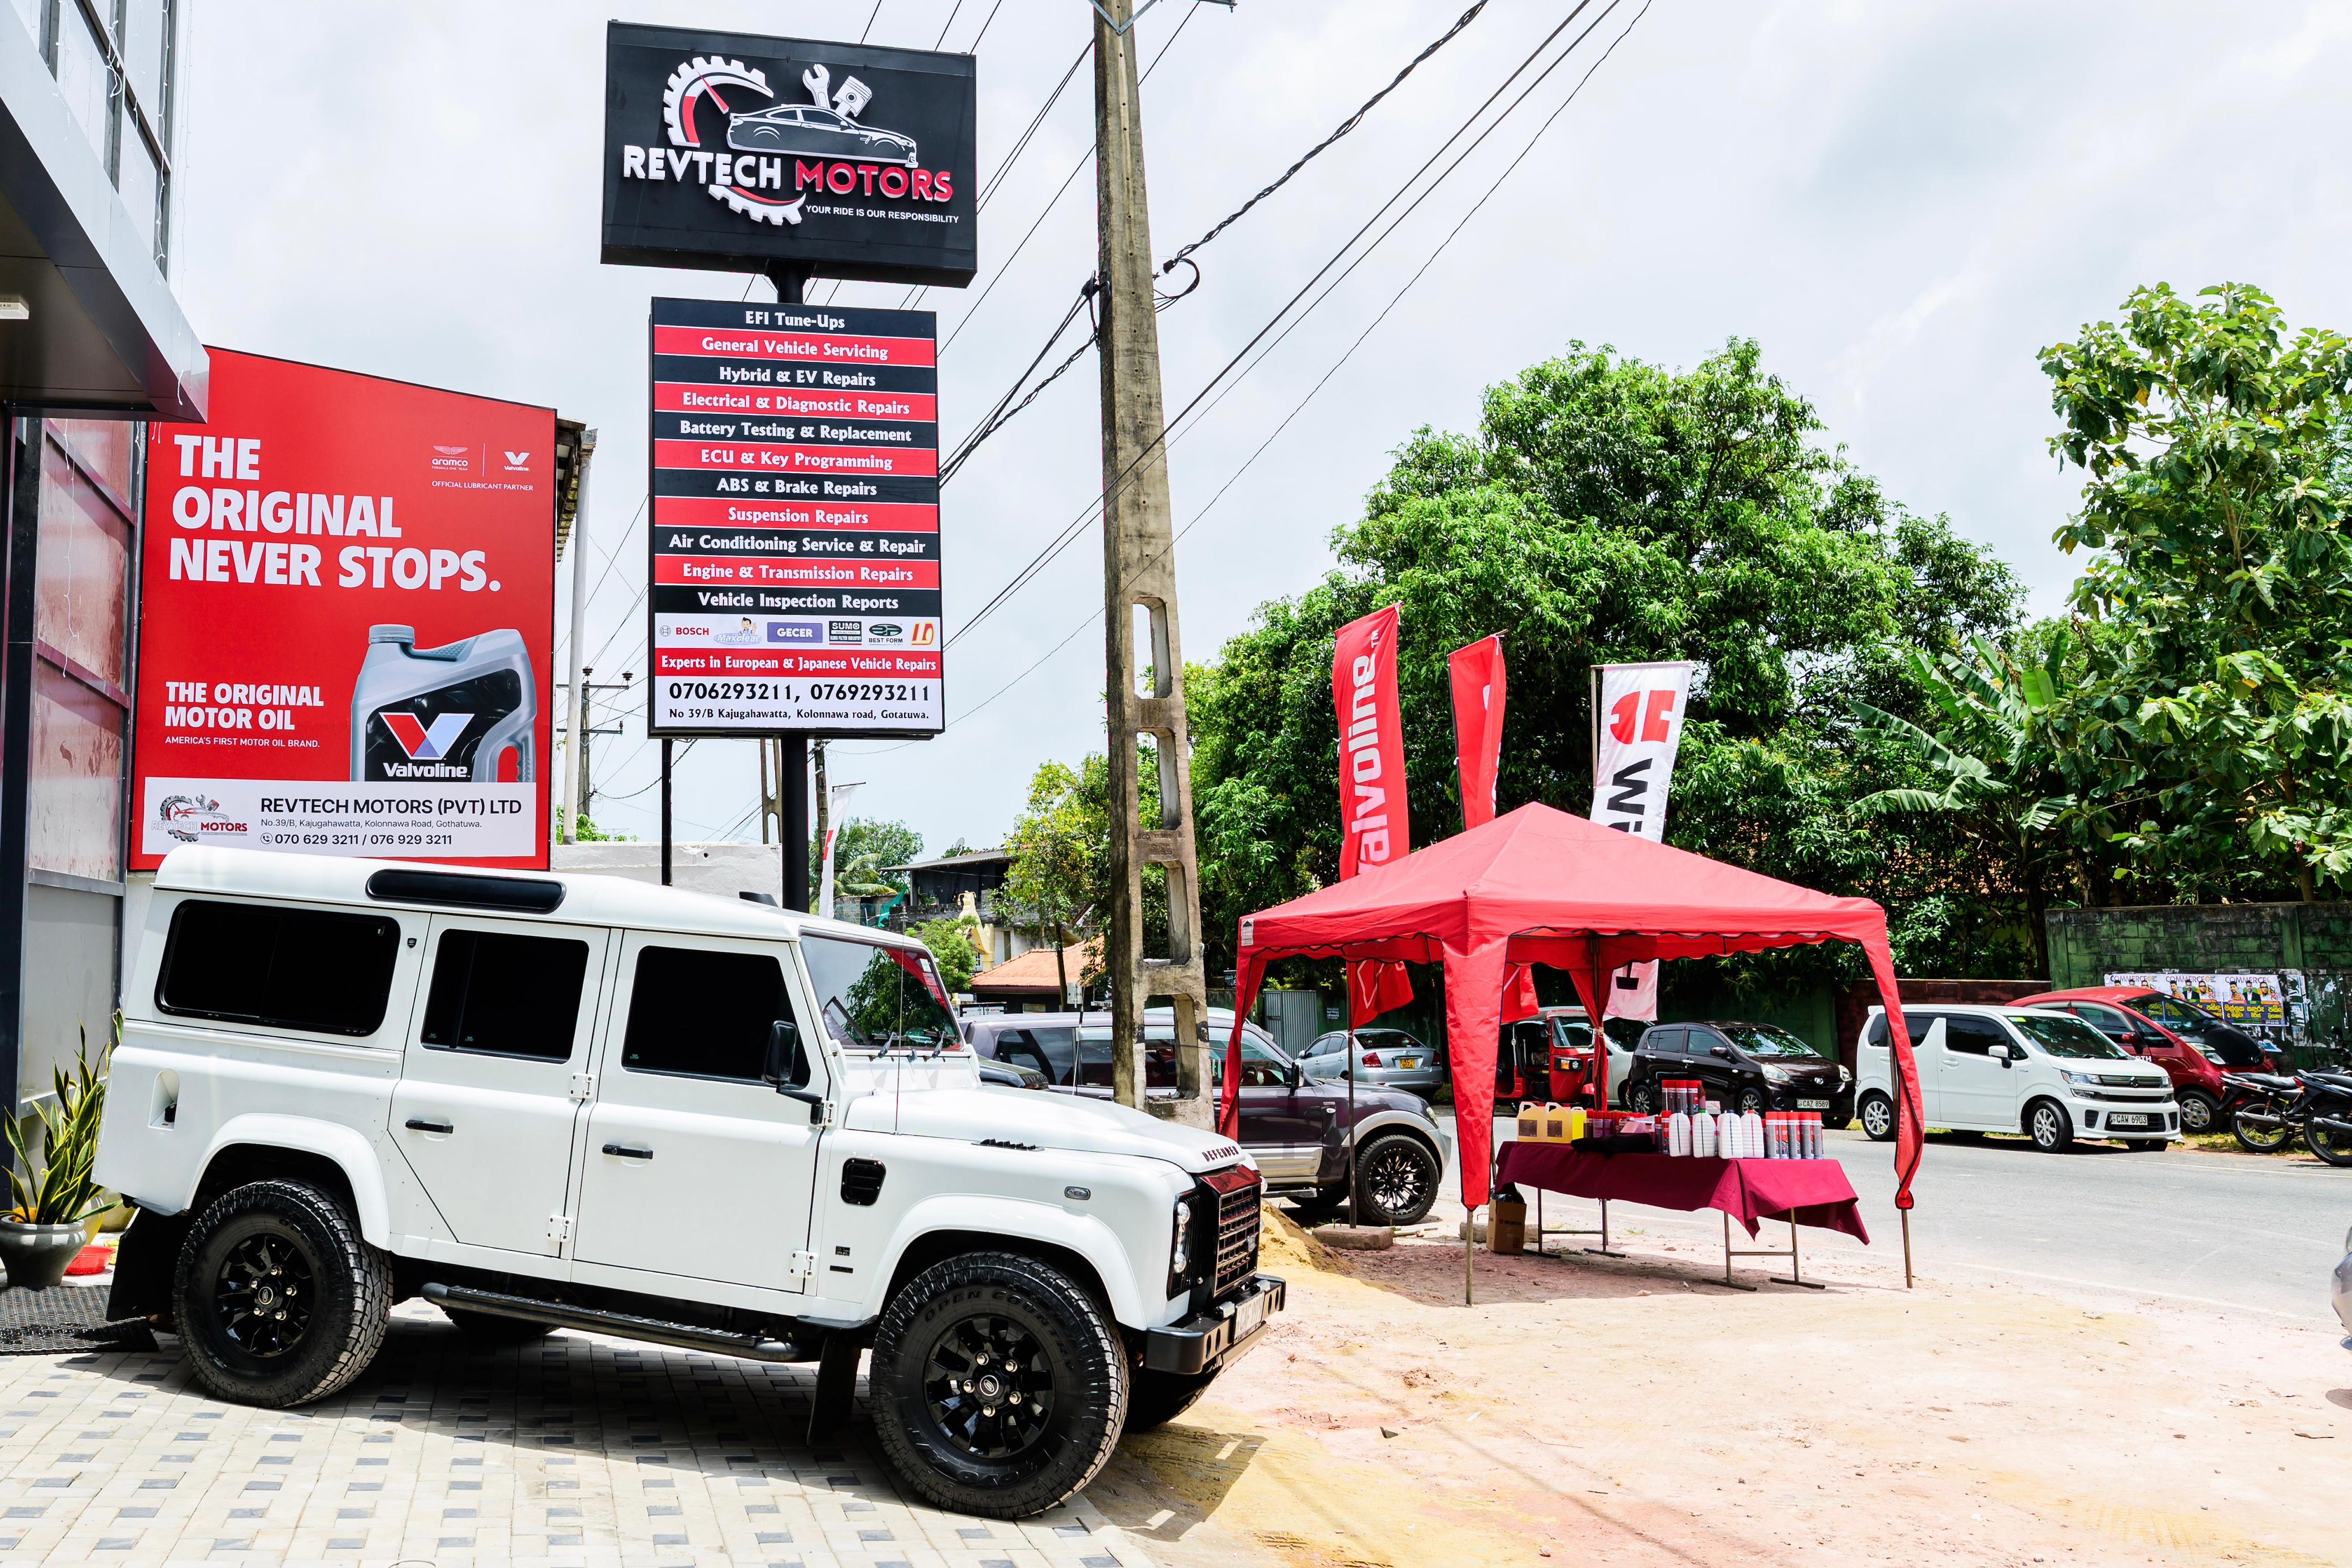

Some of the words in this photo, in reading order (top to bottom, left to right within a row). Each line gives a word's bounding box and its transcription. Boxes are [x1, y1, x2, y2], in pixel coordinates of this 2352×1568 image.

[624, 145, 781, 189] REVTECH
[795, 159, 954, 202] MOTORS
[806, 205, 831, 215] YOUR
[833, 206, 854, 216] RIDE
[856, 208, 864, 216] IS
[866, 209, 886, 218] OUR
[888, 211, 959, 223] RESPONSIBILITY
[746, 310, 769, 325] EFI
[775, 312, 845, 330] Tune-Ups
[702, 336, 758, 353] General
[763, 339, 818, 355] Vehicle
[823, 343, 888, 361] Servicing
[719, 367, 771, 383] Hybrid
[776, 371, 790, 383] &
[796, 370, 817, 383] EV
[823, 372, 876, 387] Repairs
[682, 392, 750, 408] Electrical
[756, 396, 770, 408] &
[776, 396, 851, 414] Diagnostic
[857, 400, 910, 415] Repairs
[680, 421, 736, 437] Battery
[741, 422, 794, 439] Testing
[800, 426, 814, 438] &
[820, 425, 911, 441] Replacement
[174, 434, 261, 480] THE
[701, 449, 734, 464] ECU
[740, 452, 755, 464] &
[760, 452, 789, 467] Key
[794, 453, 893, 471] Programming
[716, 478, 749, 492] ABS
[755, 480, 769, 492] &
[775, 480, 818, 494] Brake
[823, 482, 877, 497] Repairs
[172, 486, 402, 538] ORIGINAL
[728, 507, 810, 525] Suspension
[815, 509, 868, 525] Repairs
[669, 534, 694, 548] Air
[699, 535, 797, 553] Conditioning
[802, 537, 854, 552] Service
[859, 540, 874, 552] &
[879, 539, 926, 554] Repair
[170, 538, 322, 587] NEVER
[339, 545, 501, 592] STOPS.
[683, 563, 733, 579] Engine
[739, 566, 753, 578] &
[759, 565, 854, 581] Transmission
[860, 567, 914, 582] Repairs
[698, 592, 753, 607] Vehicle
[759, 594, 836, 610] Inspection
[842, 595, 898, 611] Reports
[717, 633, 760, 642] Maxclear
[776, 627, 813, 638] GECER
[661, 656, 706, 670] Experts
[710, 656, 720, 668] in
[725, 657, 779, 670] European
[783, 658, 794, 669] &
[798, 657, 846, 672] Japanese
[851, 658, 892, 670] Vehicle
[896, 659, 936, 672] Repairs
[166, 681, 207, 703] THE
[214, 683, 324, 707] ORIGINAL
[669, 683, 801, 703] 0706293211,
[810, 685, 929, 701] 0769293211
[165, 706, 252, 729] MOTOR
[258, 709, 295, 730] OIL
[669, 709, 684, 718] No
[688, 708, 714, 720] 39/B
[718, 709, 791, 720] Kajugahawatta,
[797, 709, 849, 719] Kolonnawa
[853, 709, 876, 720] road,
[881, 709, 929, 720] Gotatuwa.
[165, 736, 211, 746] AMERICA'S
[213, 737, 238, 746] FIRST
[240, 738, 270, 747] MOTOR
[271, 738, 286, 747] OIL
[288, 739, 320, 748] BRAND.
[383, 763, 468, 778] Valvoline
[261, 798, 348, 814] REVTECH
[353, 799, 433, 814] MOTORS
[438, 798, 486, 816] (PVT)
[490, 800, 521, 814] LTD
[151, 821, 198, 830] REVTECH
[201, 822, 248, 831] MOTORS
[261, 818, 297, 828] No.39/B,
[300, 818, 362, 829] Kajugahawatta,
[411, 820, 434, 828] Road,
[275, 834, 300, 844] 070
[303, 834, 328, 844] 629
[332, 834, 358, 844] 3211
[362, 834, 367, 846] /
[370, 834, 395, 844] 076
[398, 835, 422, 844] 929
[426, 835, 452, 844] 3211
[2132, 1115, 2147, 1124] 6903
[1202, 1146, 1239, 1162] DEFENDER
[925, 1289, 982, 1323] OPEN
[992, 1290, 1074, 1371] COUNTRY
